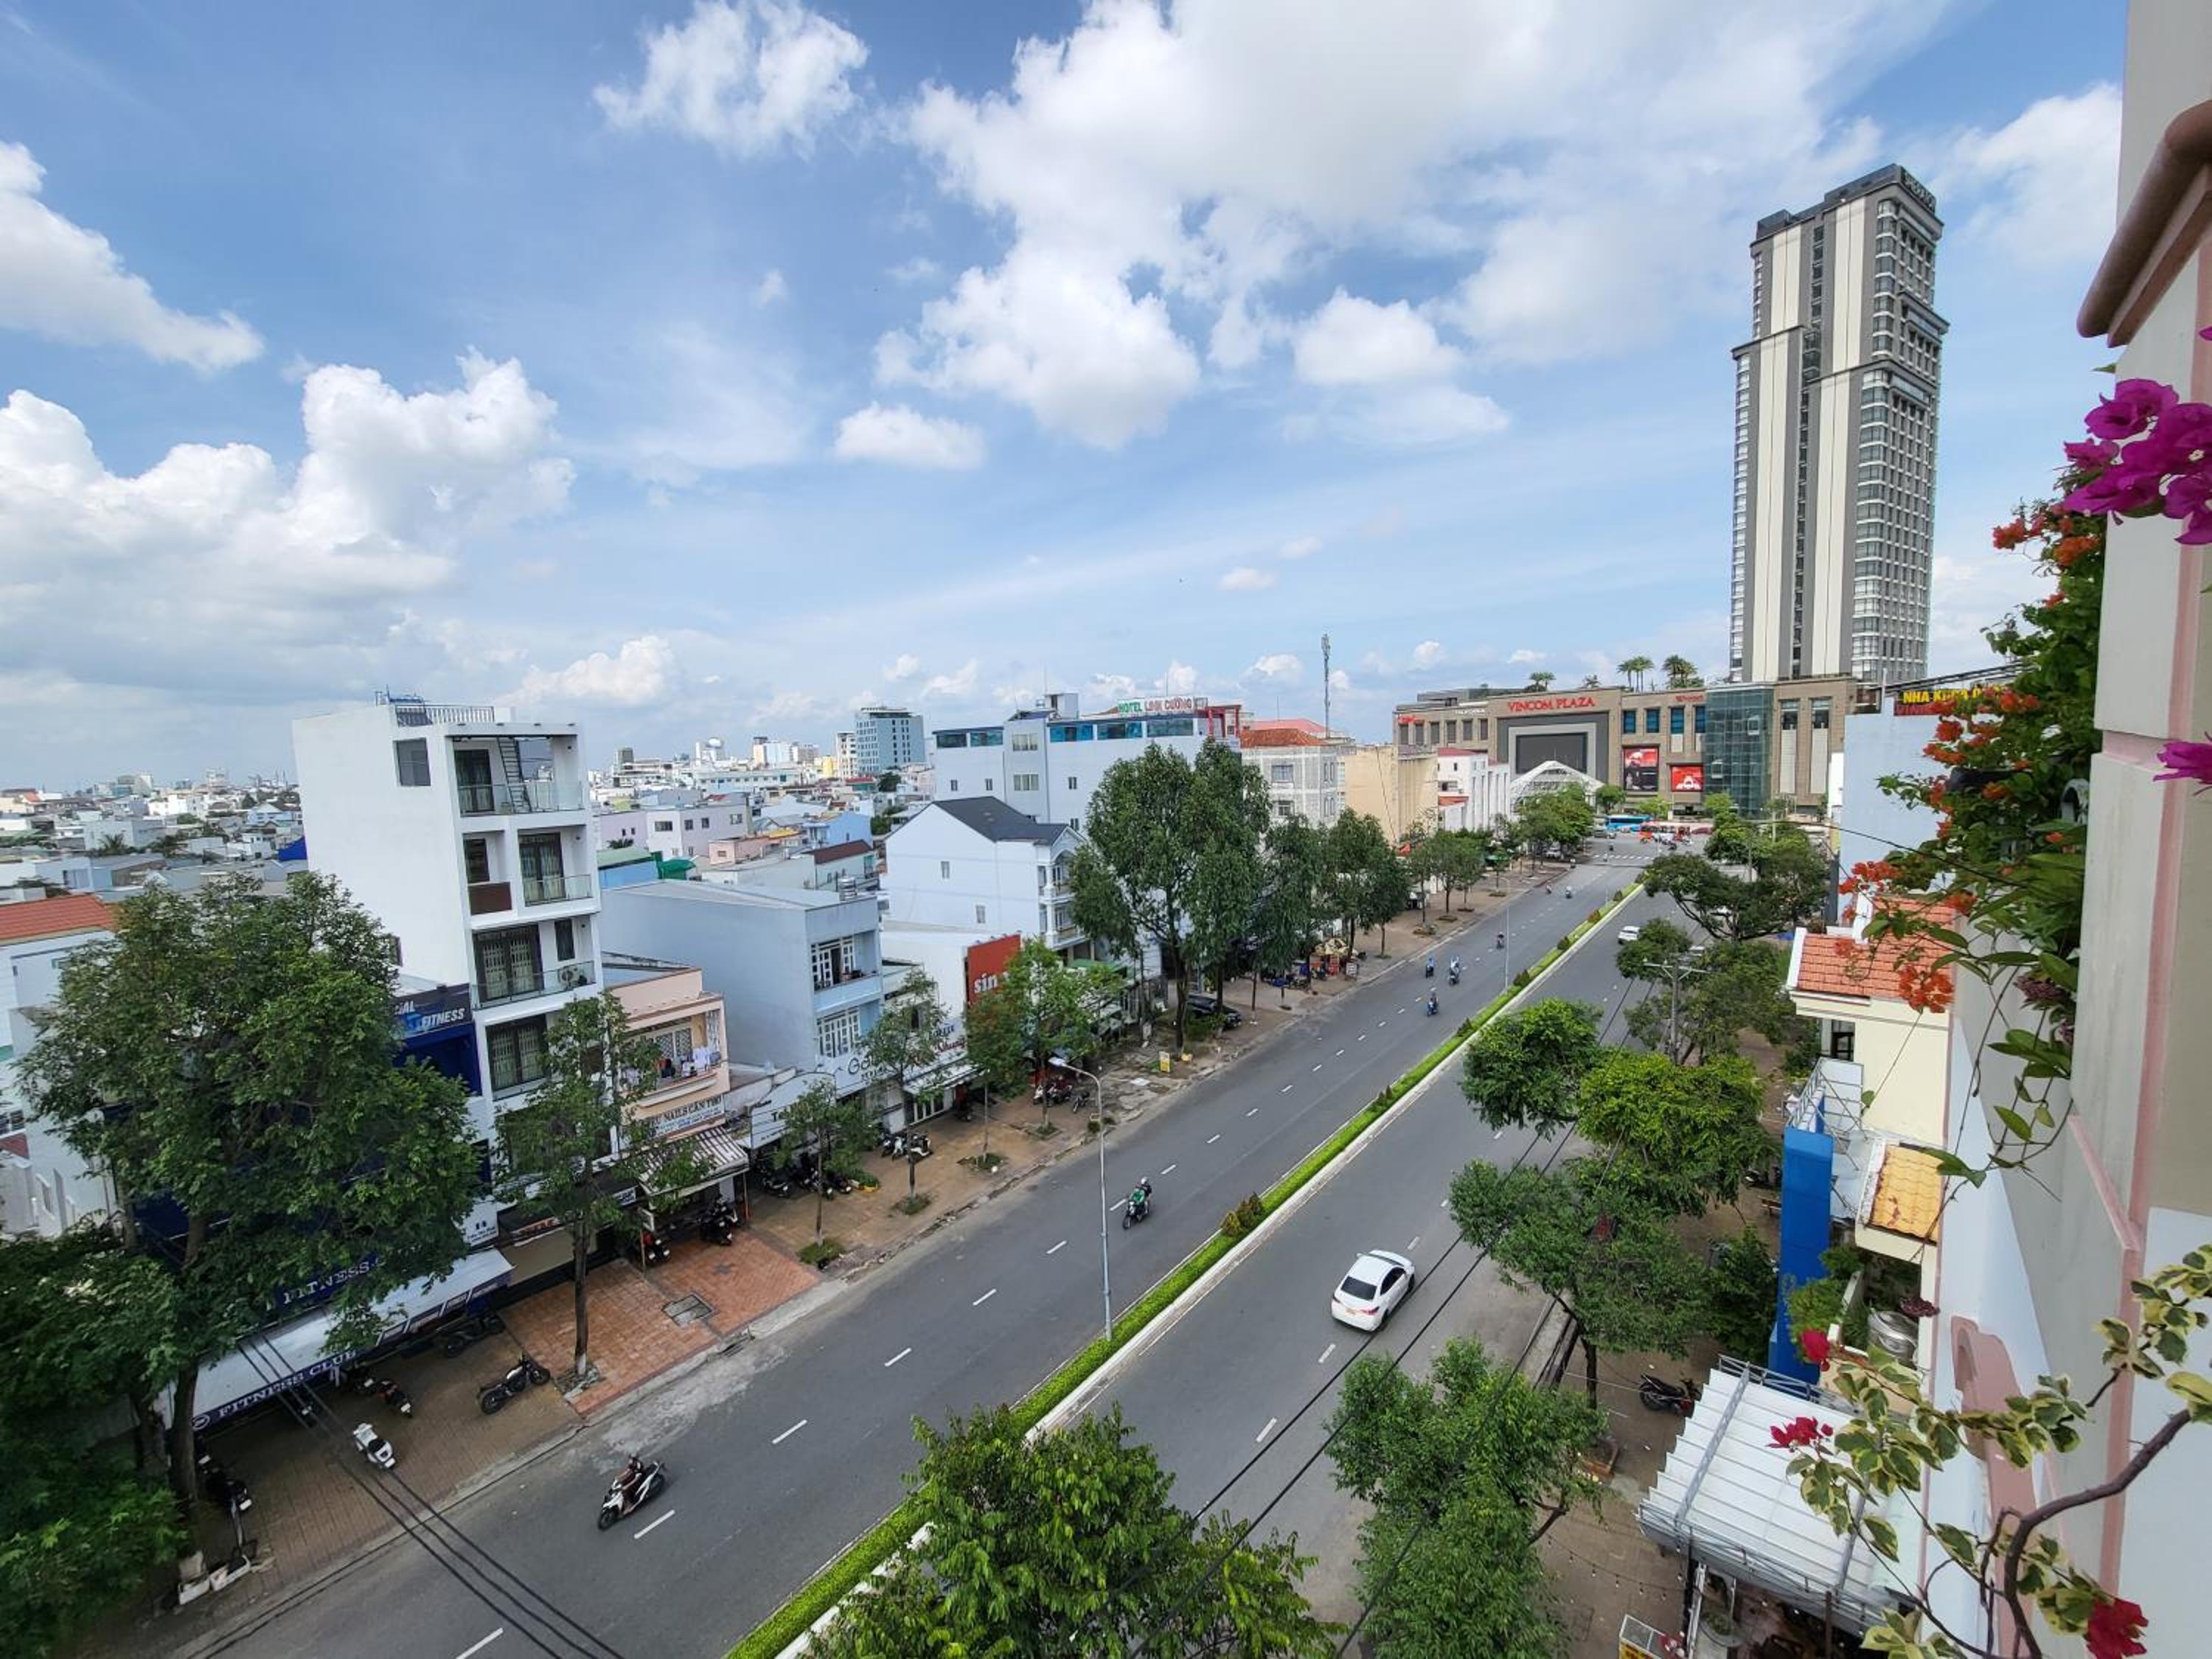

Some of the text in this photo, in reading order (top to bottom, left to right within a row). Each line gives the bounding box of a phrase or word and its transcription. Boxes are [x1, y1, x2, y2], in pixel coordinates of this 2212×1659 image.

[1119, 701, 1142, 712] HOTEL
[1509, 696, 1595, 712] VINCOM PLAZA
[421, 1008, 465, 1029] FITNESS
[219, 1352, 357, 1417] FITNESS CLUB
